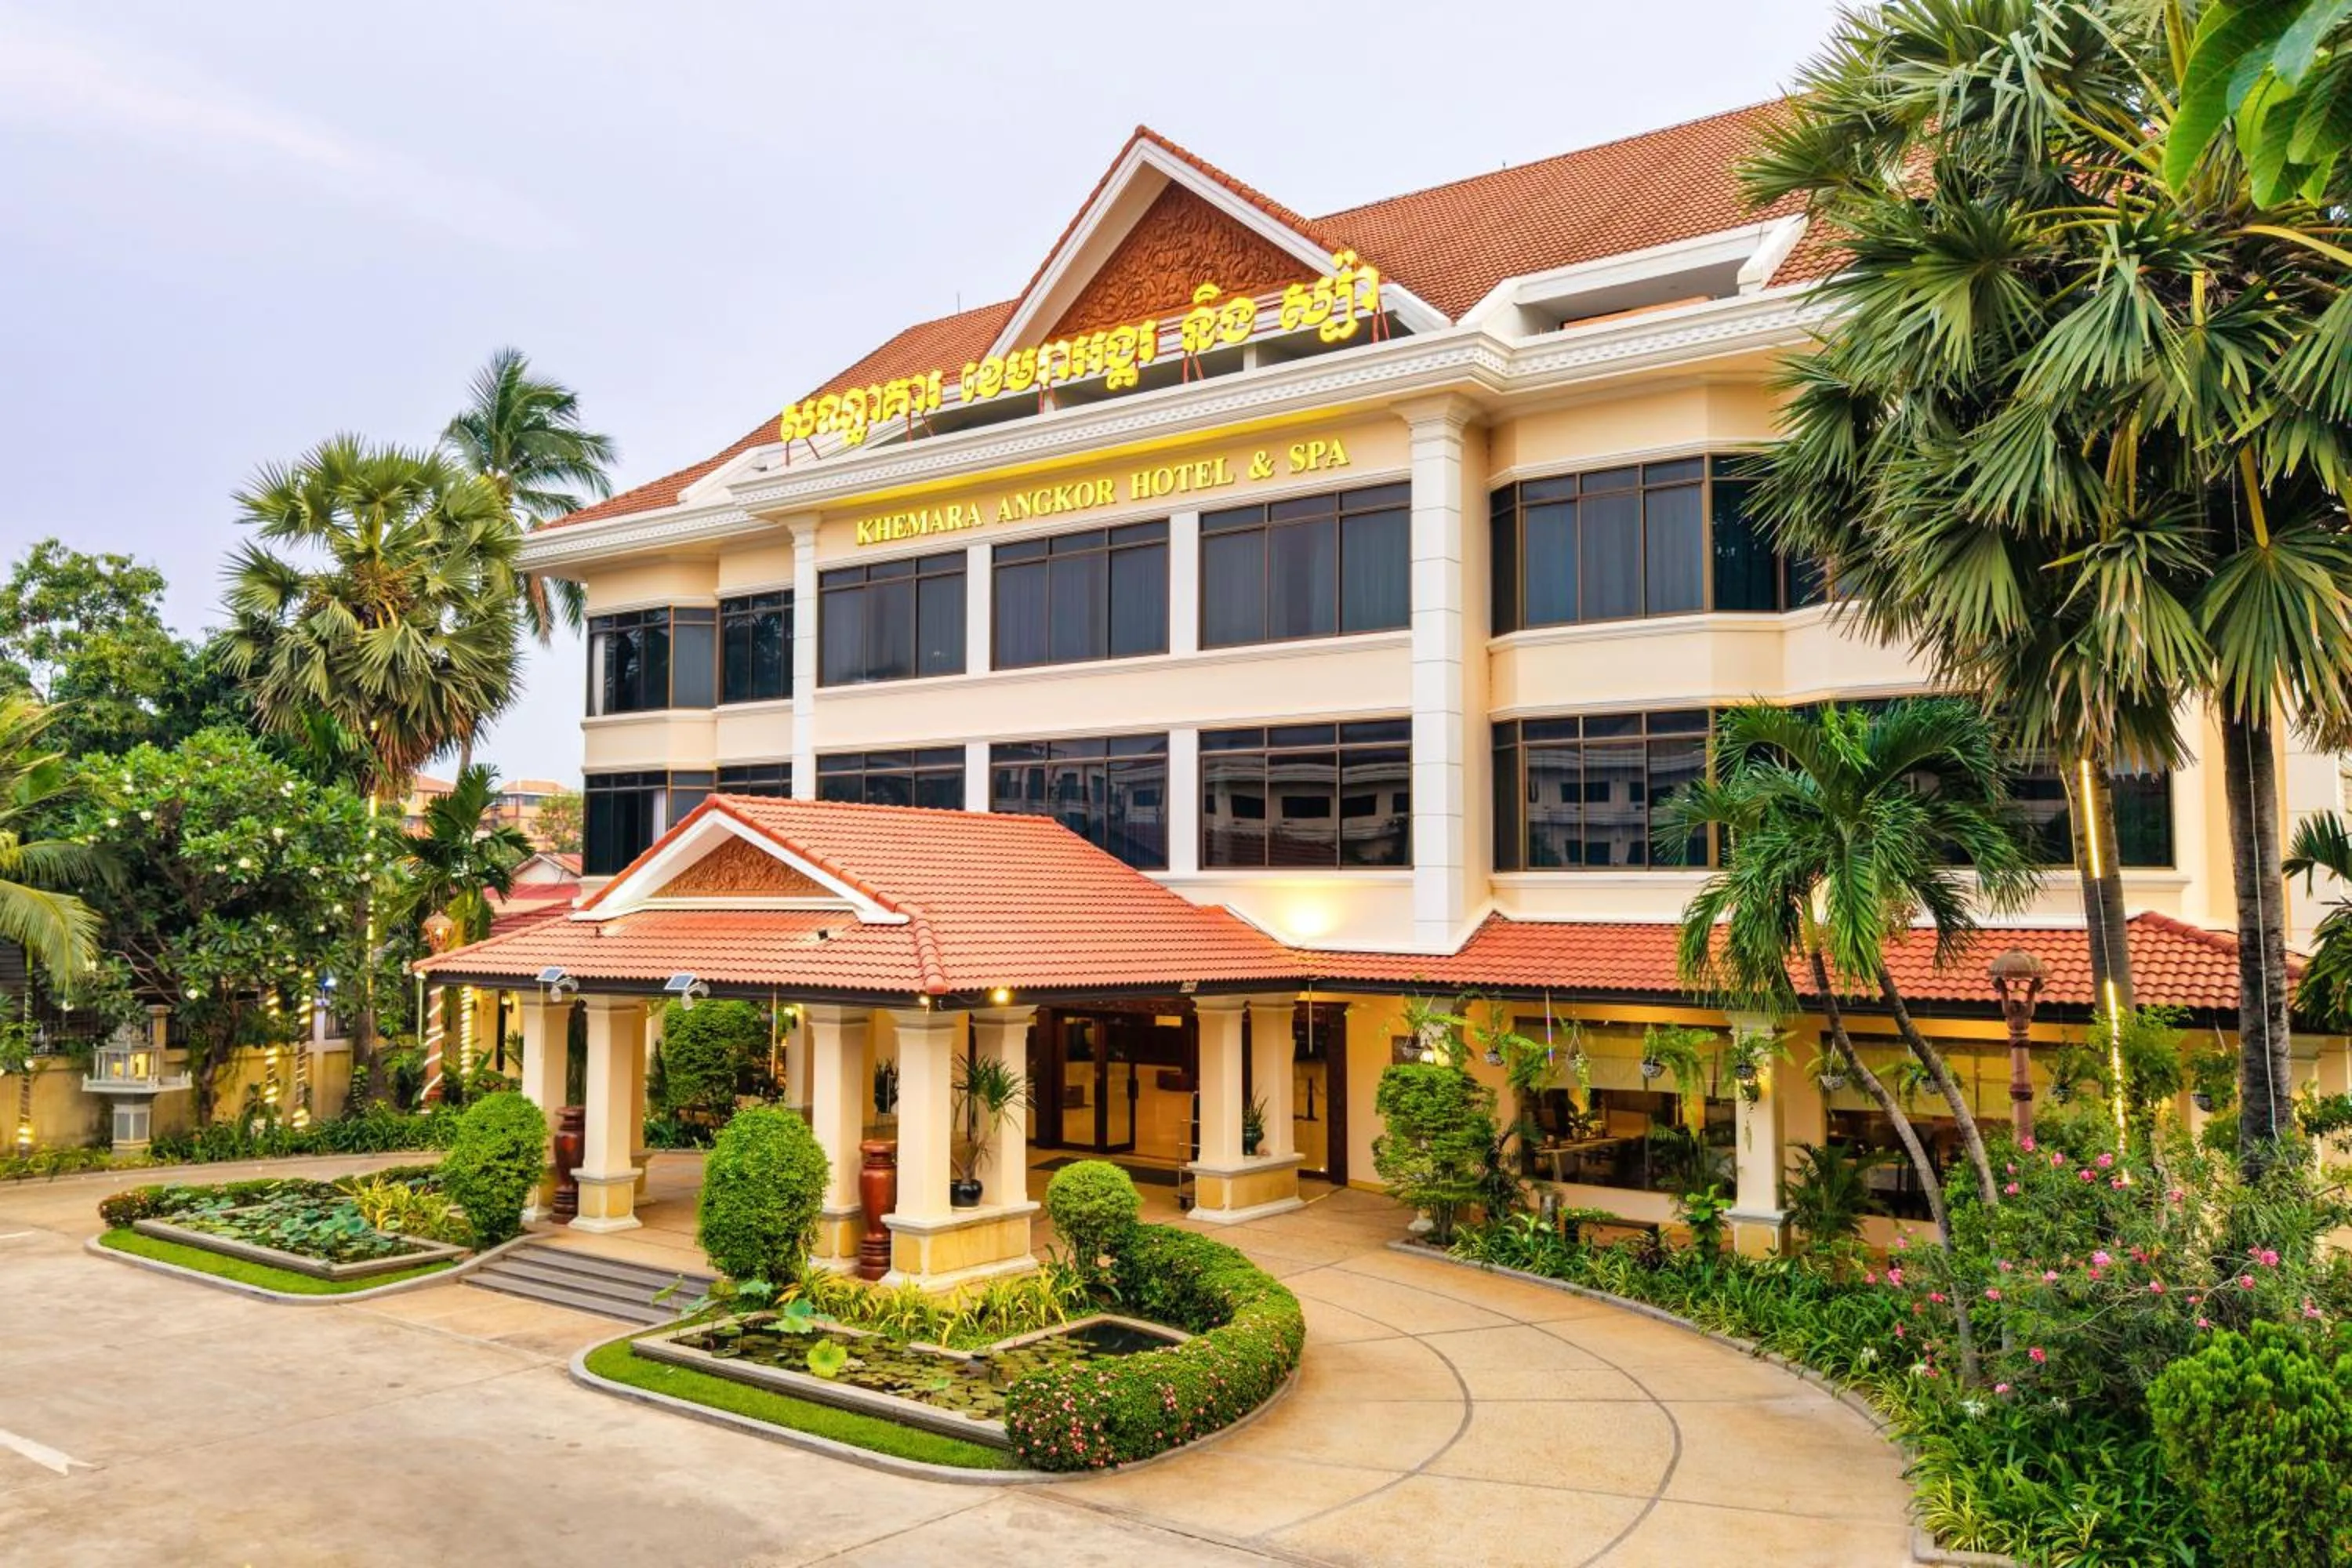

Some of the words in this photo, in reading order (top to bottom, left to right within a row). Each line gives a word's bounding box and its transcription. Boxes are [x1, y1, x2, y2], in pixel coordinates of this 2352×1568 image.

[856, 503, 982, 546] KHEMARA
[996, 478, 1116, 522] ANGKOR
[1130, 457, 1234, 500] HOTEL
[1247, 449, 1274, 481] &
[1288, 438, 1349, 472] SPA
